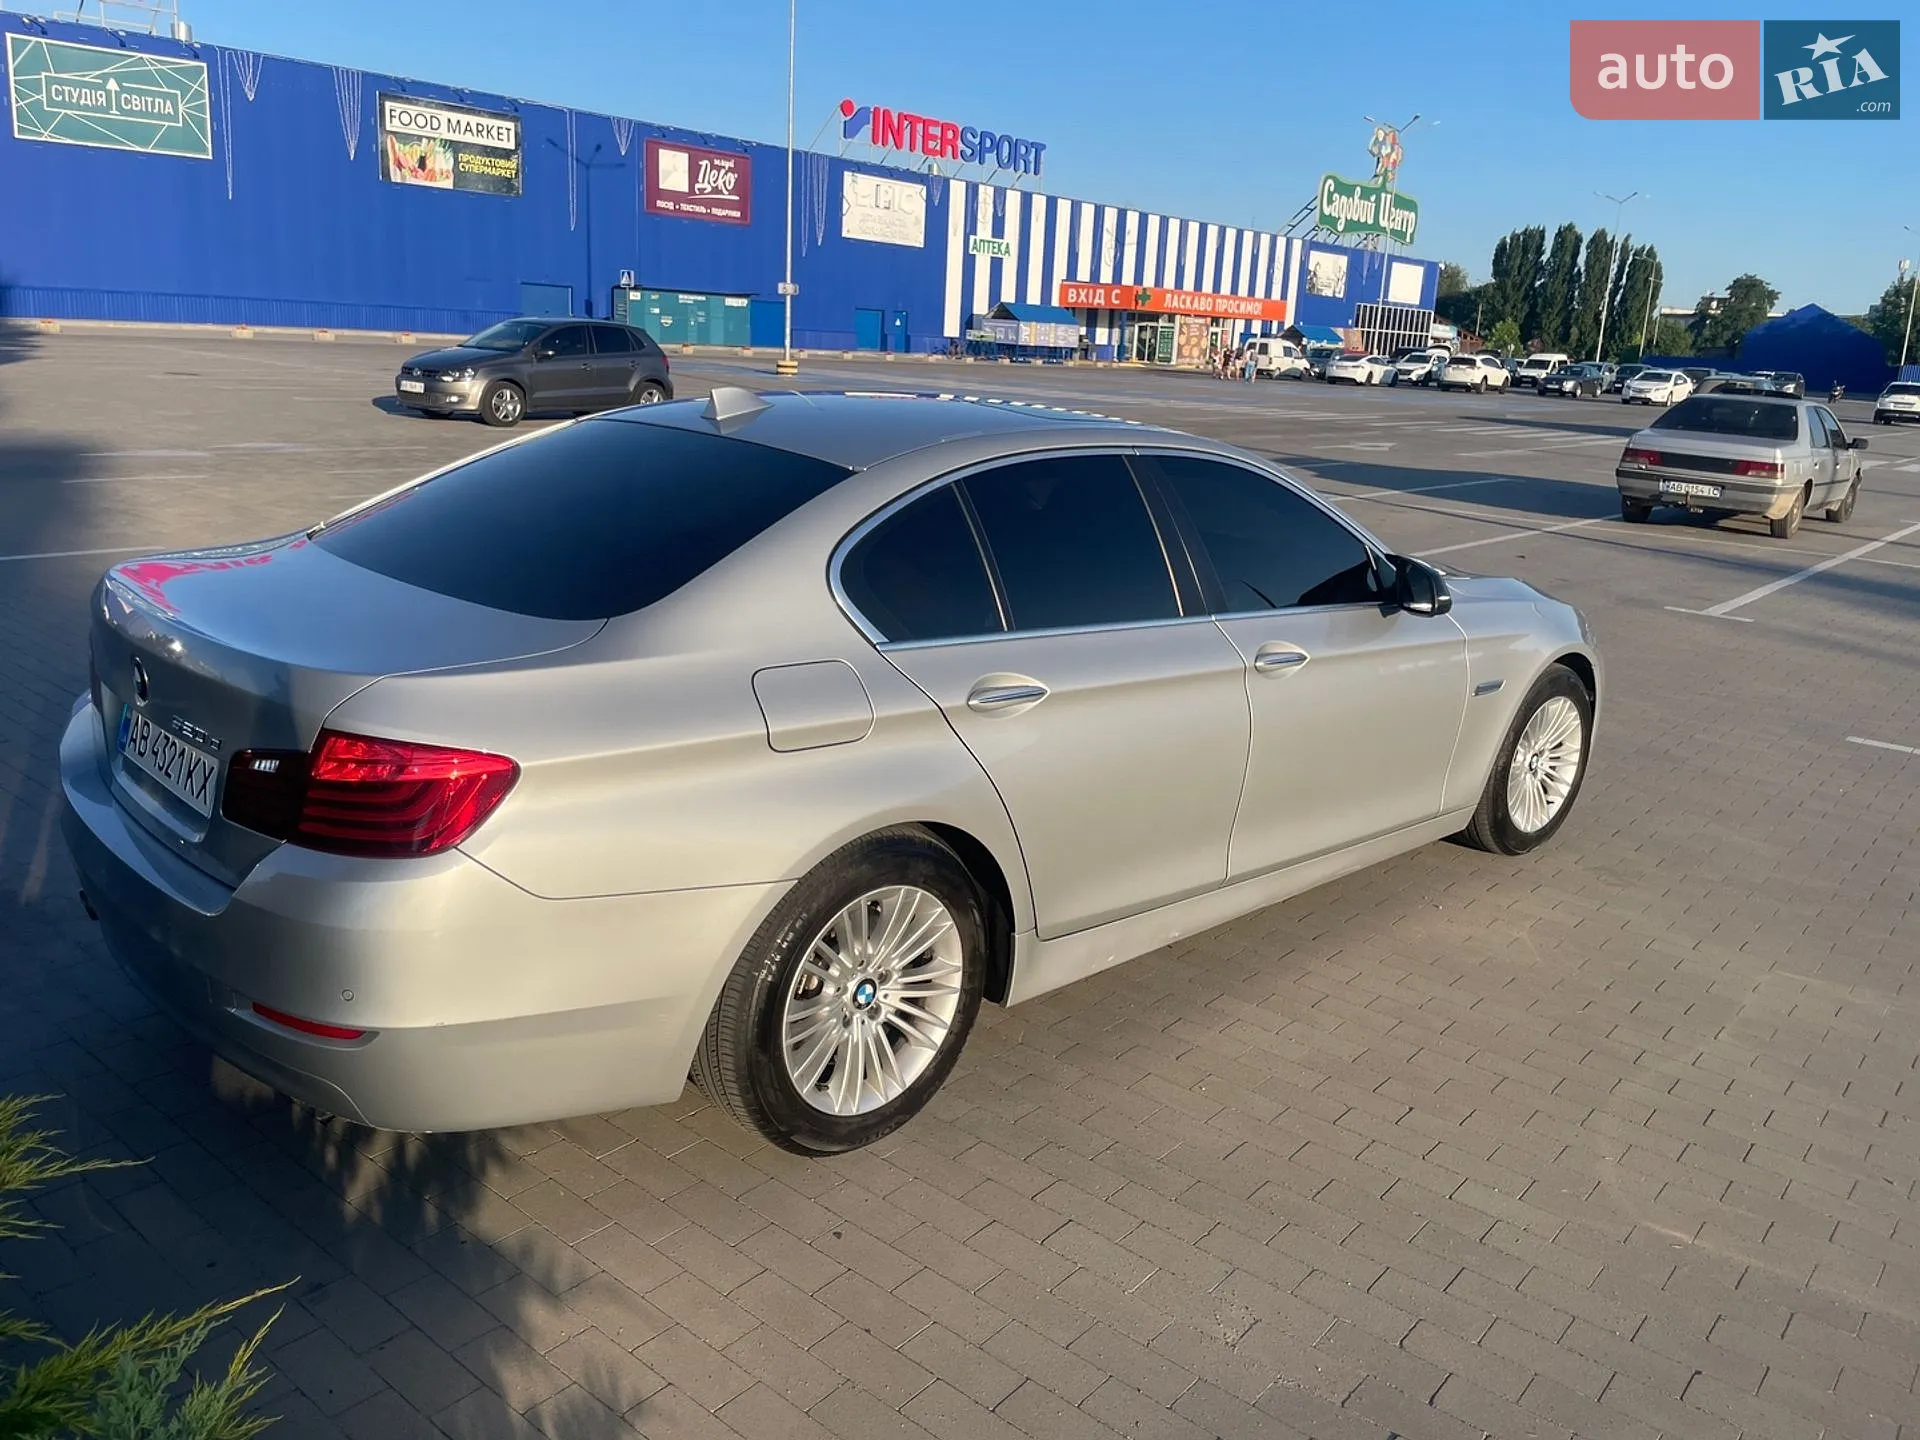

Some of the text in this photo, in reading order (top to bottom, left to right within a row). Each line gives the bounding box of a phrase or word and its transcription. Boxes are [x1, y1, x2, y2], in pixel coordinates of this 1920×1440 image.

[51, 84, 174, 115] СТУДІЯ СВІТЛА
[388, 108, 512, 143] FOOD MARKET
[871, 106, 1047, 176] INTERSPORT
[458, 153, 517, 169] ПРОДУКТОВИЙ
[458, 162, 516, 178] СУПЕРМАРКЕТ
[1321, 179, 1416, 242] Садовий Центр
[971, 238, 1011, 257] АПТЕКА
[1067, 288, 1106, 305] ВХІД
[1163, 293, 1213, 312] ЛАСКАВО
[1215, 298, 1263, 316] ПРОСИМО!
